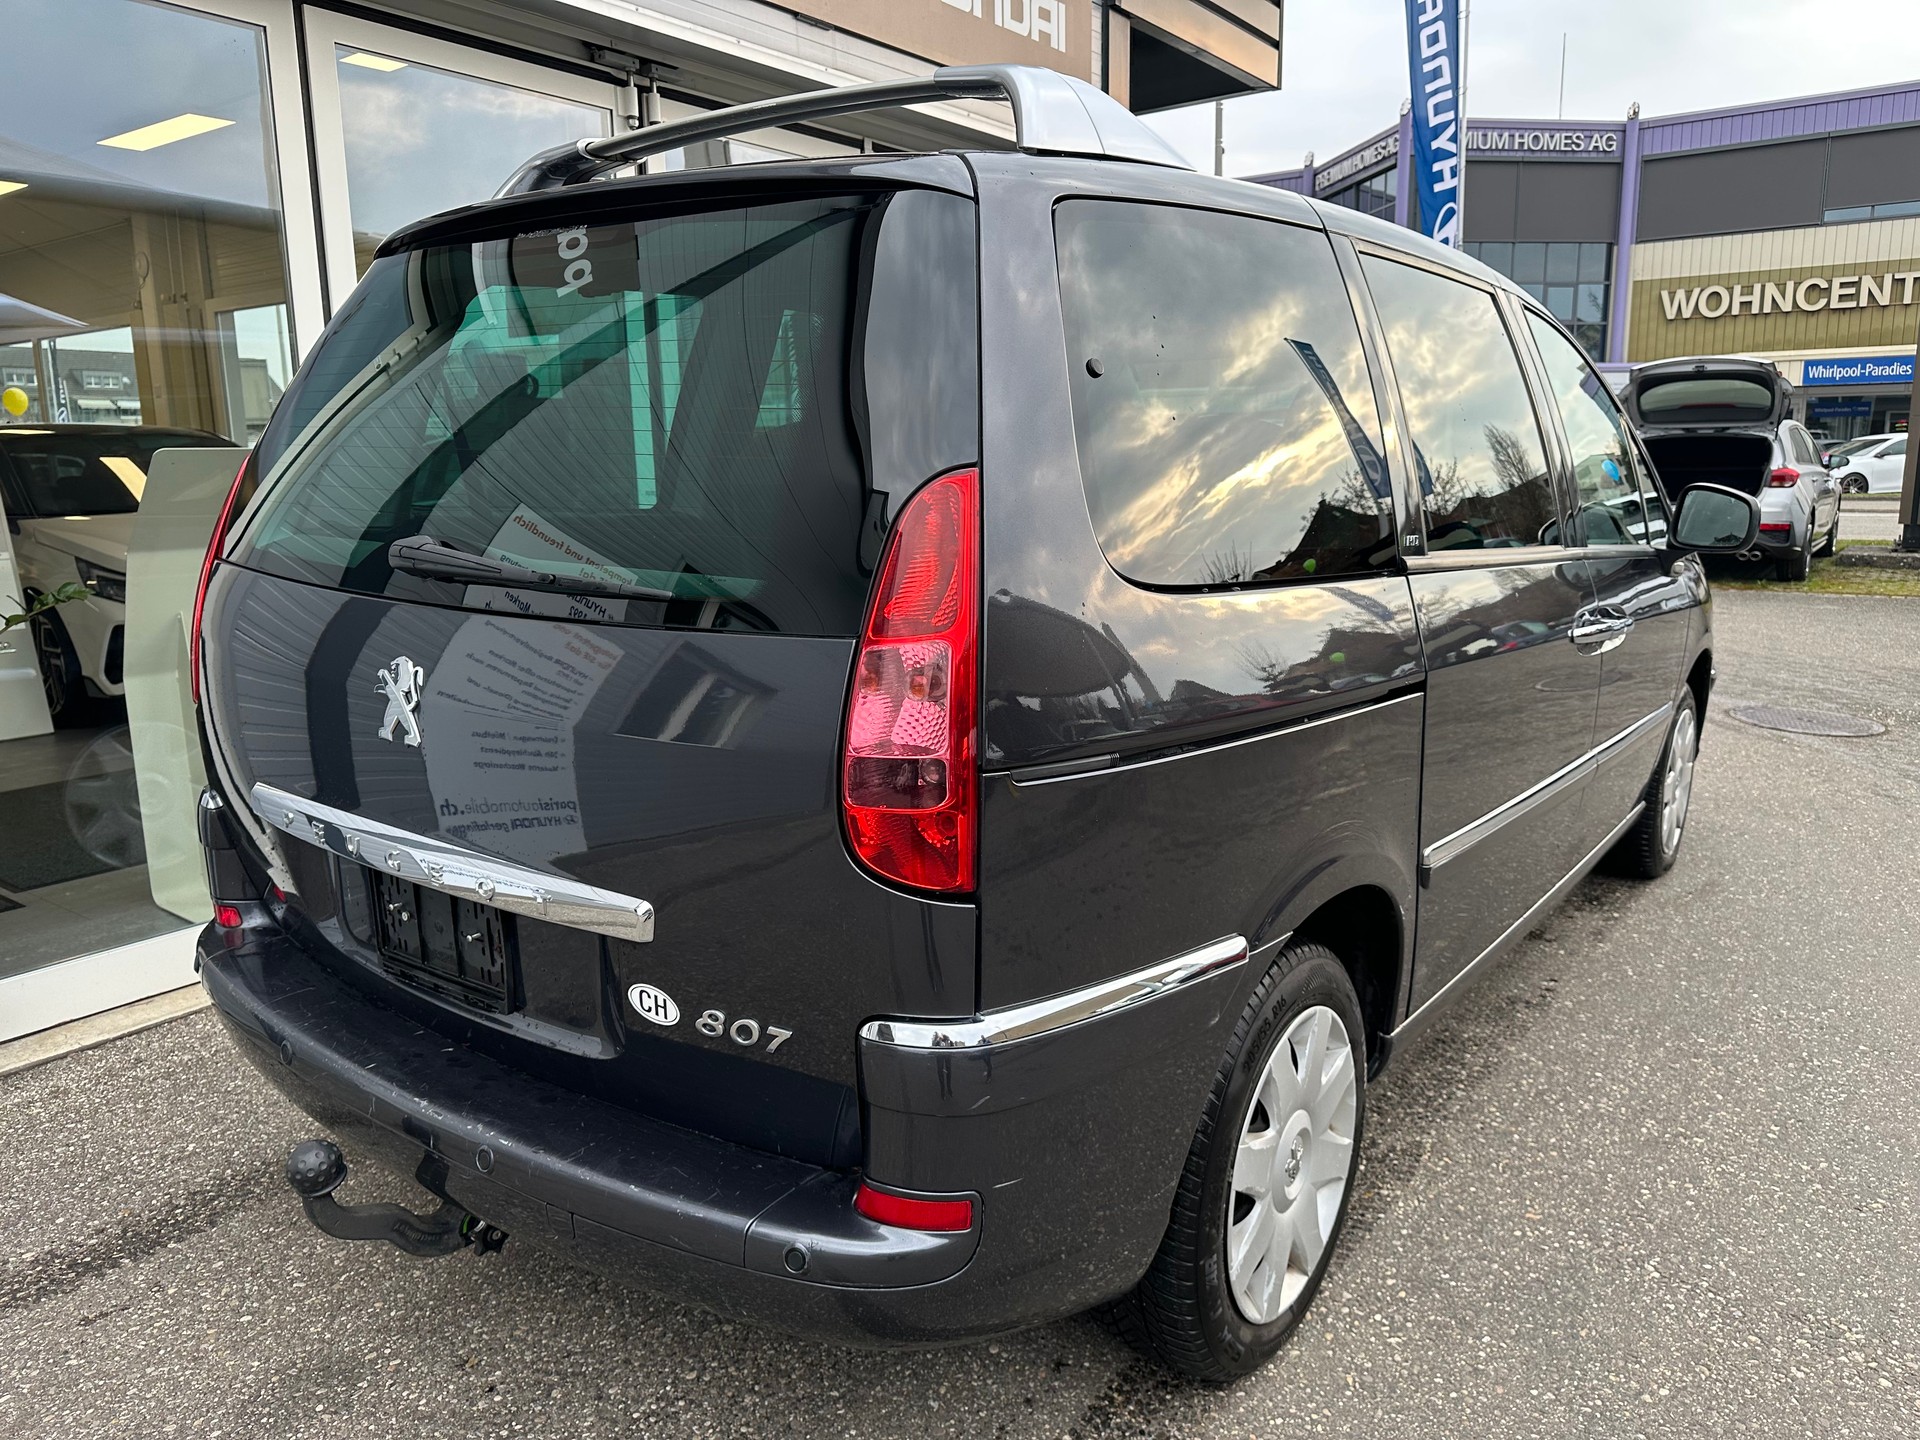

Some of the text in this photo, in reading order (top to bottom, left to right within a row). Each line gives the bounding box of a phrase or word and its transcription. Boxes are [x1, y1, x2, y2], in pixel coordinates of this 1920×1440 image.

[941, 0, 1066, 53] DAI
[1514, 132, 1584, 151] HOMES
[1588, 133, 1617, 152] AG
[1660, 271, 1920, 321] WOHNCENT
[1808, 362, 1912, 380] Whirlpool-Paradies
[281, 810, 553, 915] PEUGEOT
[639, 989, 668, 1020] CH
[695, 1009, 793, 1054] 807
